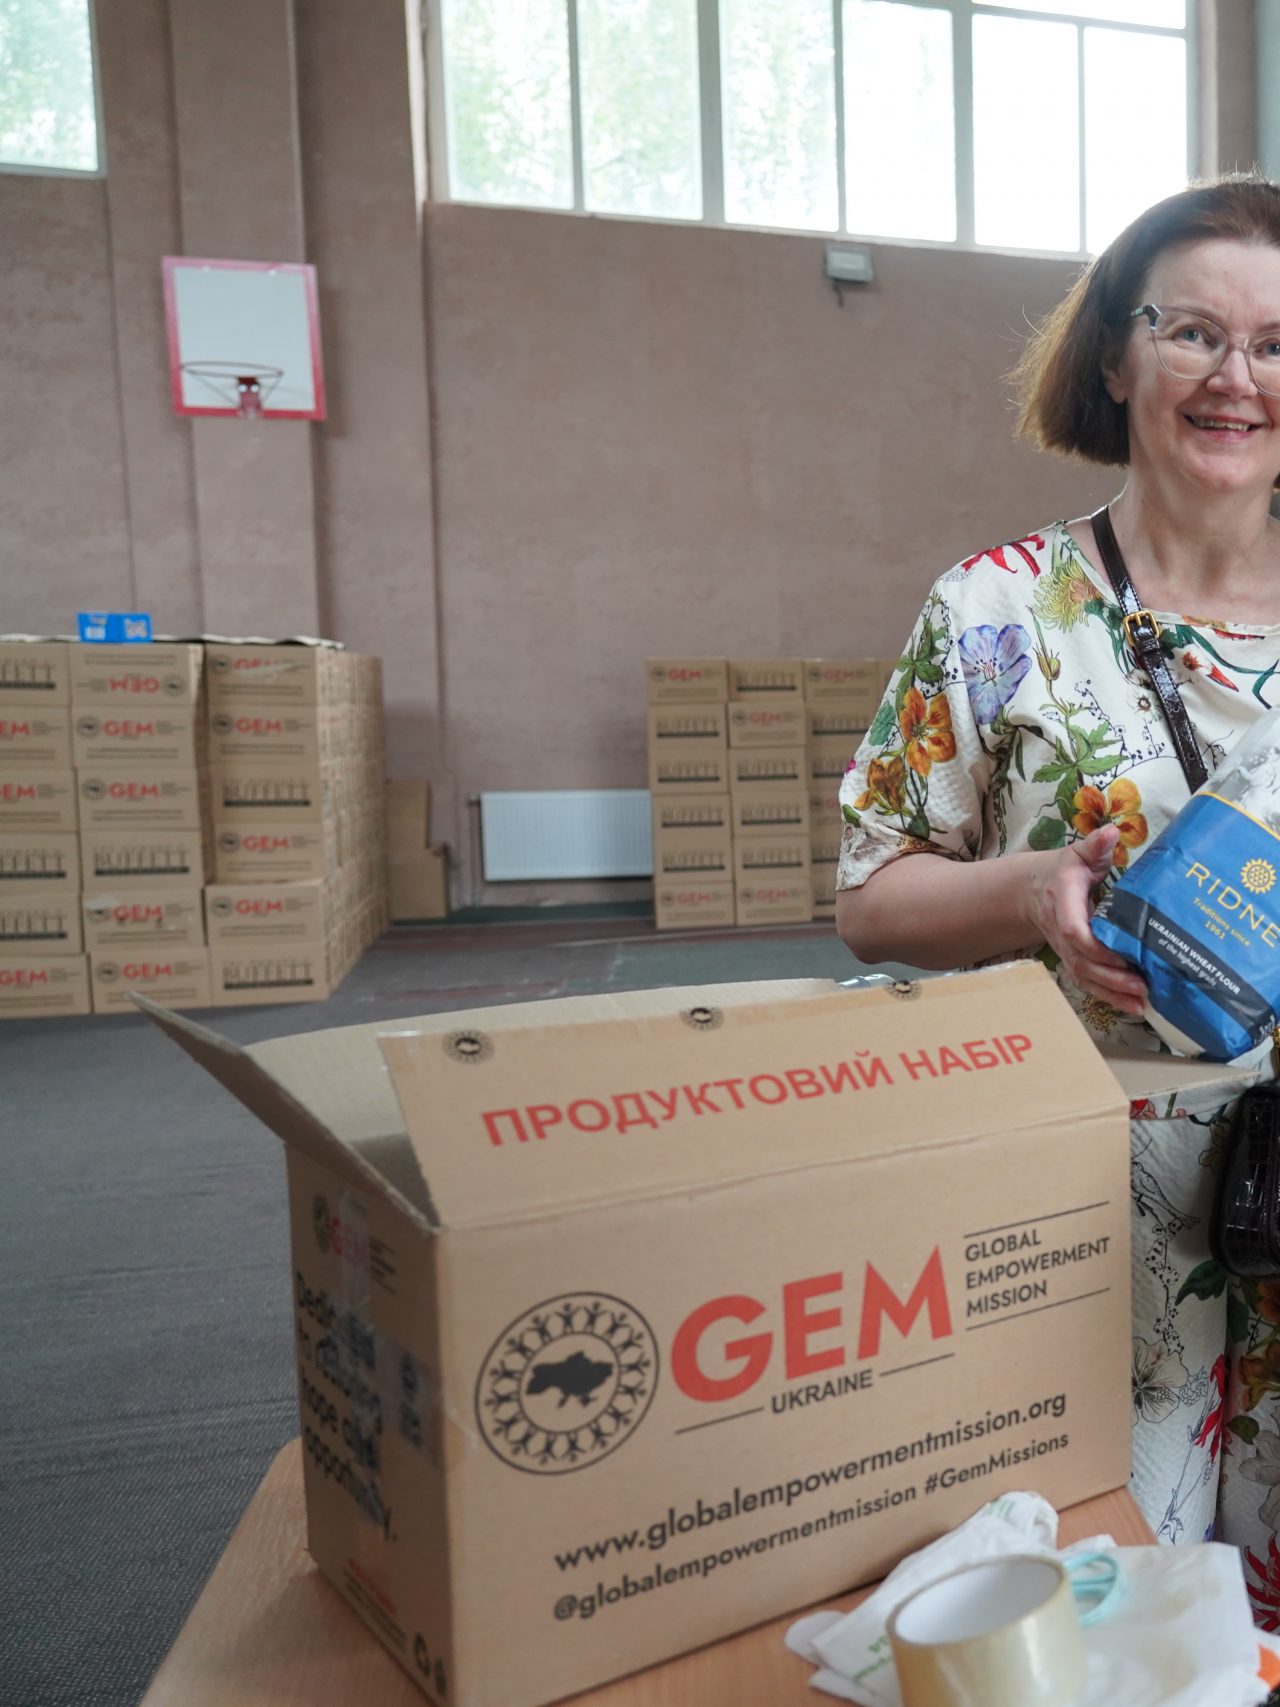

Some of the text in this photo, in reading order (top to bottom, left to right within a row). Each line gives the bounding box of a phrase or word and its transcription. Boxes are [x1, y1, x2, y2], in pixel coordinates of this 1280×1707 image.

[0, 720, 30, 736] EM
[103, 719, 154, 736] GEM
[235, 717, 283, 733] GEM
[0, 782, 36, 799] EM
[108, 782, 160, 798] GEM
[241, 835, 290, 850] GEM
[113, 903, 164, 921] GEM
[235, 898, 283, 914] GEM
[1193, 896, 1231, 931] Traditions
[122, 963, 174, 979] GEM
[1147, 918, 1241, 995] UKRAINIAN WHEAT FLOUR
[1176, 950, 1201, 974] highest
[481, 1033, 1035, 1147] ПРОДУКТОВИЙ НАБІР
[964, 1228, 1043, 1263] GLOBAL
[965, 1237, 1111, 1290] EMPOWERMENT
[965, 1280, 1049, 1319] MISSION
[670, 1245, 954, 1404] GEM
[771, 1368, 875, 1416] UKRAINE
[553, 1393, 1068, 1573] www.globalempowermentmission.org
[553, 1430, 1070, 1621] @globalempowermentmission #GemMissions
